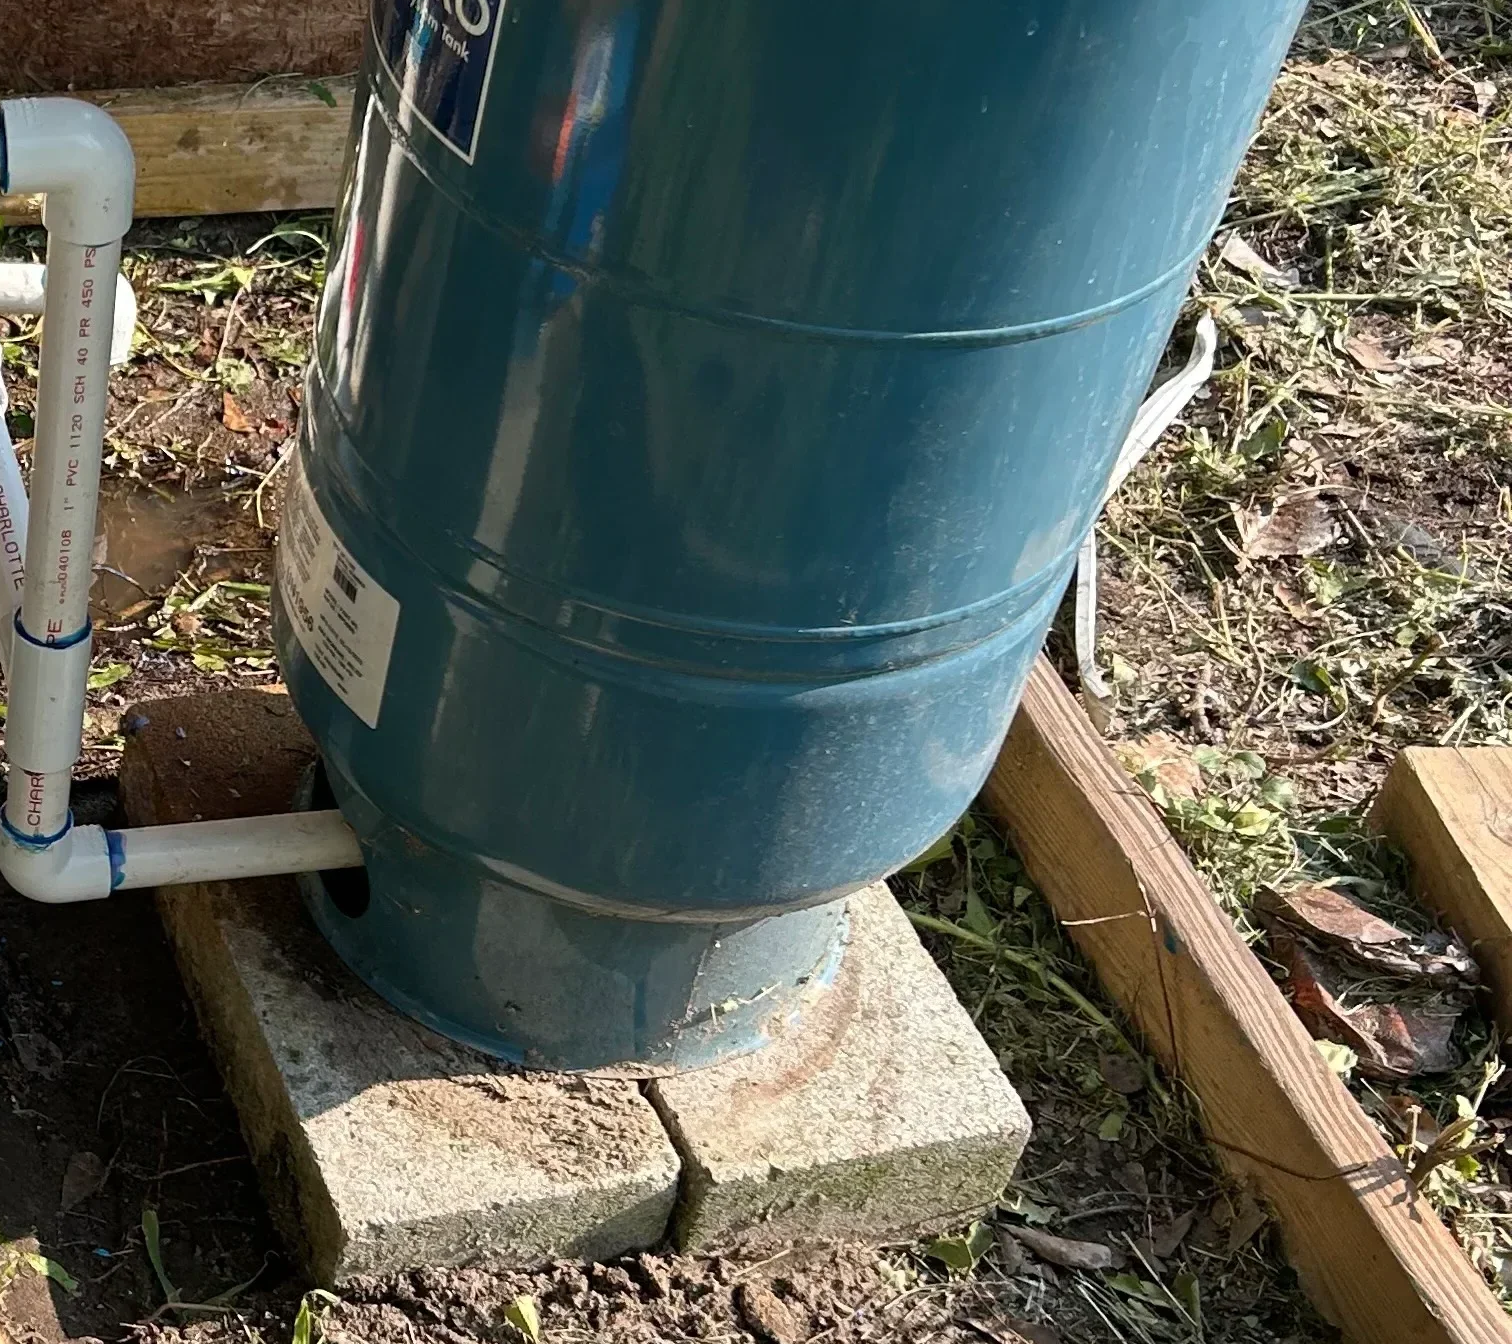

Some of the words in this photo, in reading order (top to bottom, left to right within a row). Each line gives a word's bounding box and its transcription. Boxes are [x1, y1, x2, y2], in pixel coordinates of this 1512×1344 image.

[441, 22, 470, 64] Tank
[82, 278, 94, 304] 450
[79, 317, 91, 338] PR
[77, 347, 88, 366] 40
[74, 375, 86, 405] SCH
[70, 414, 83, 449] 1120
[66, 459, 80, 487] PVC
